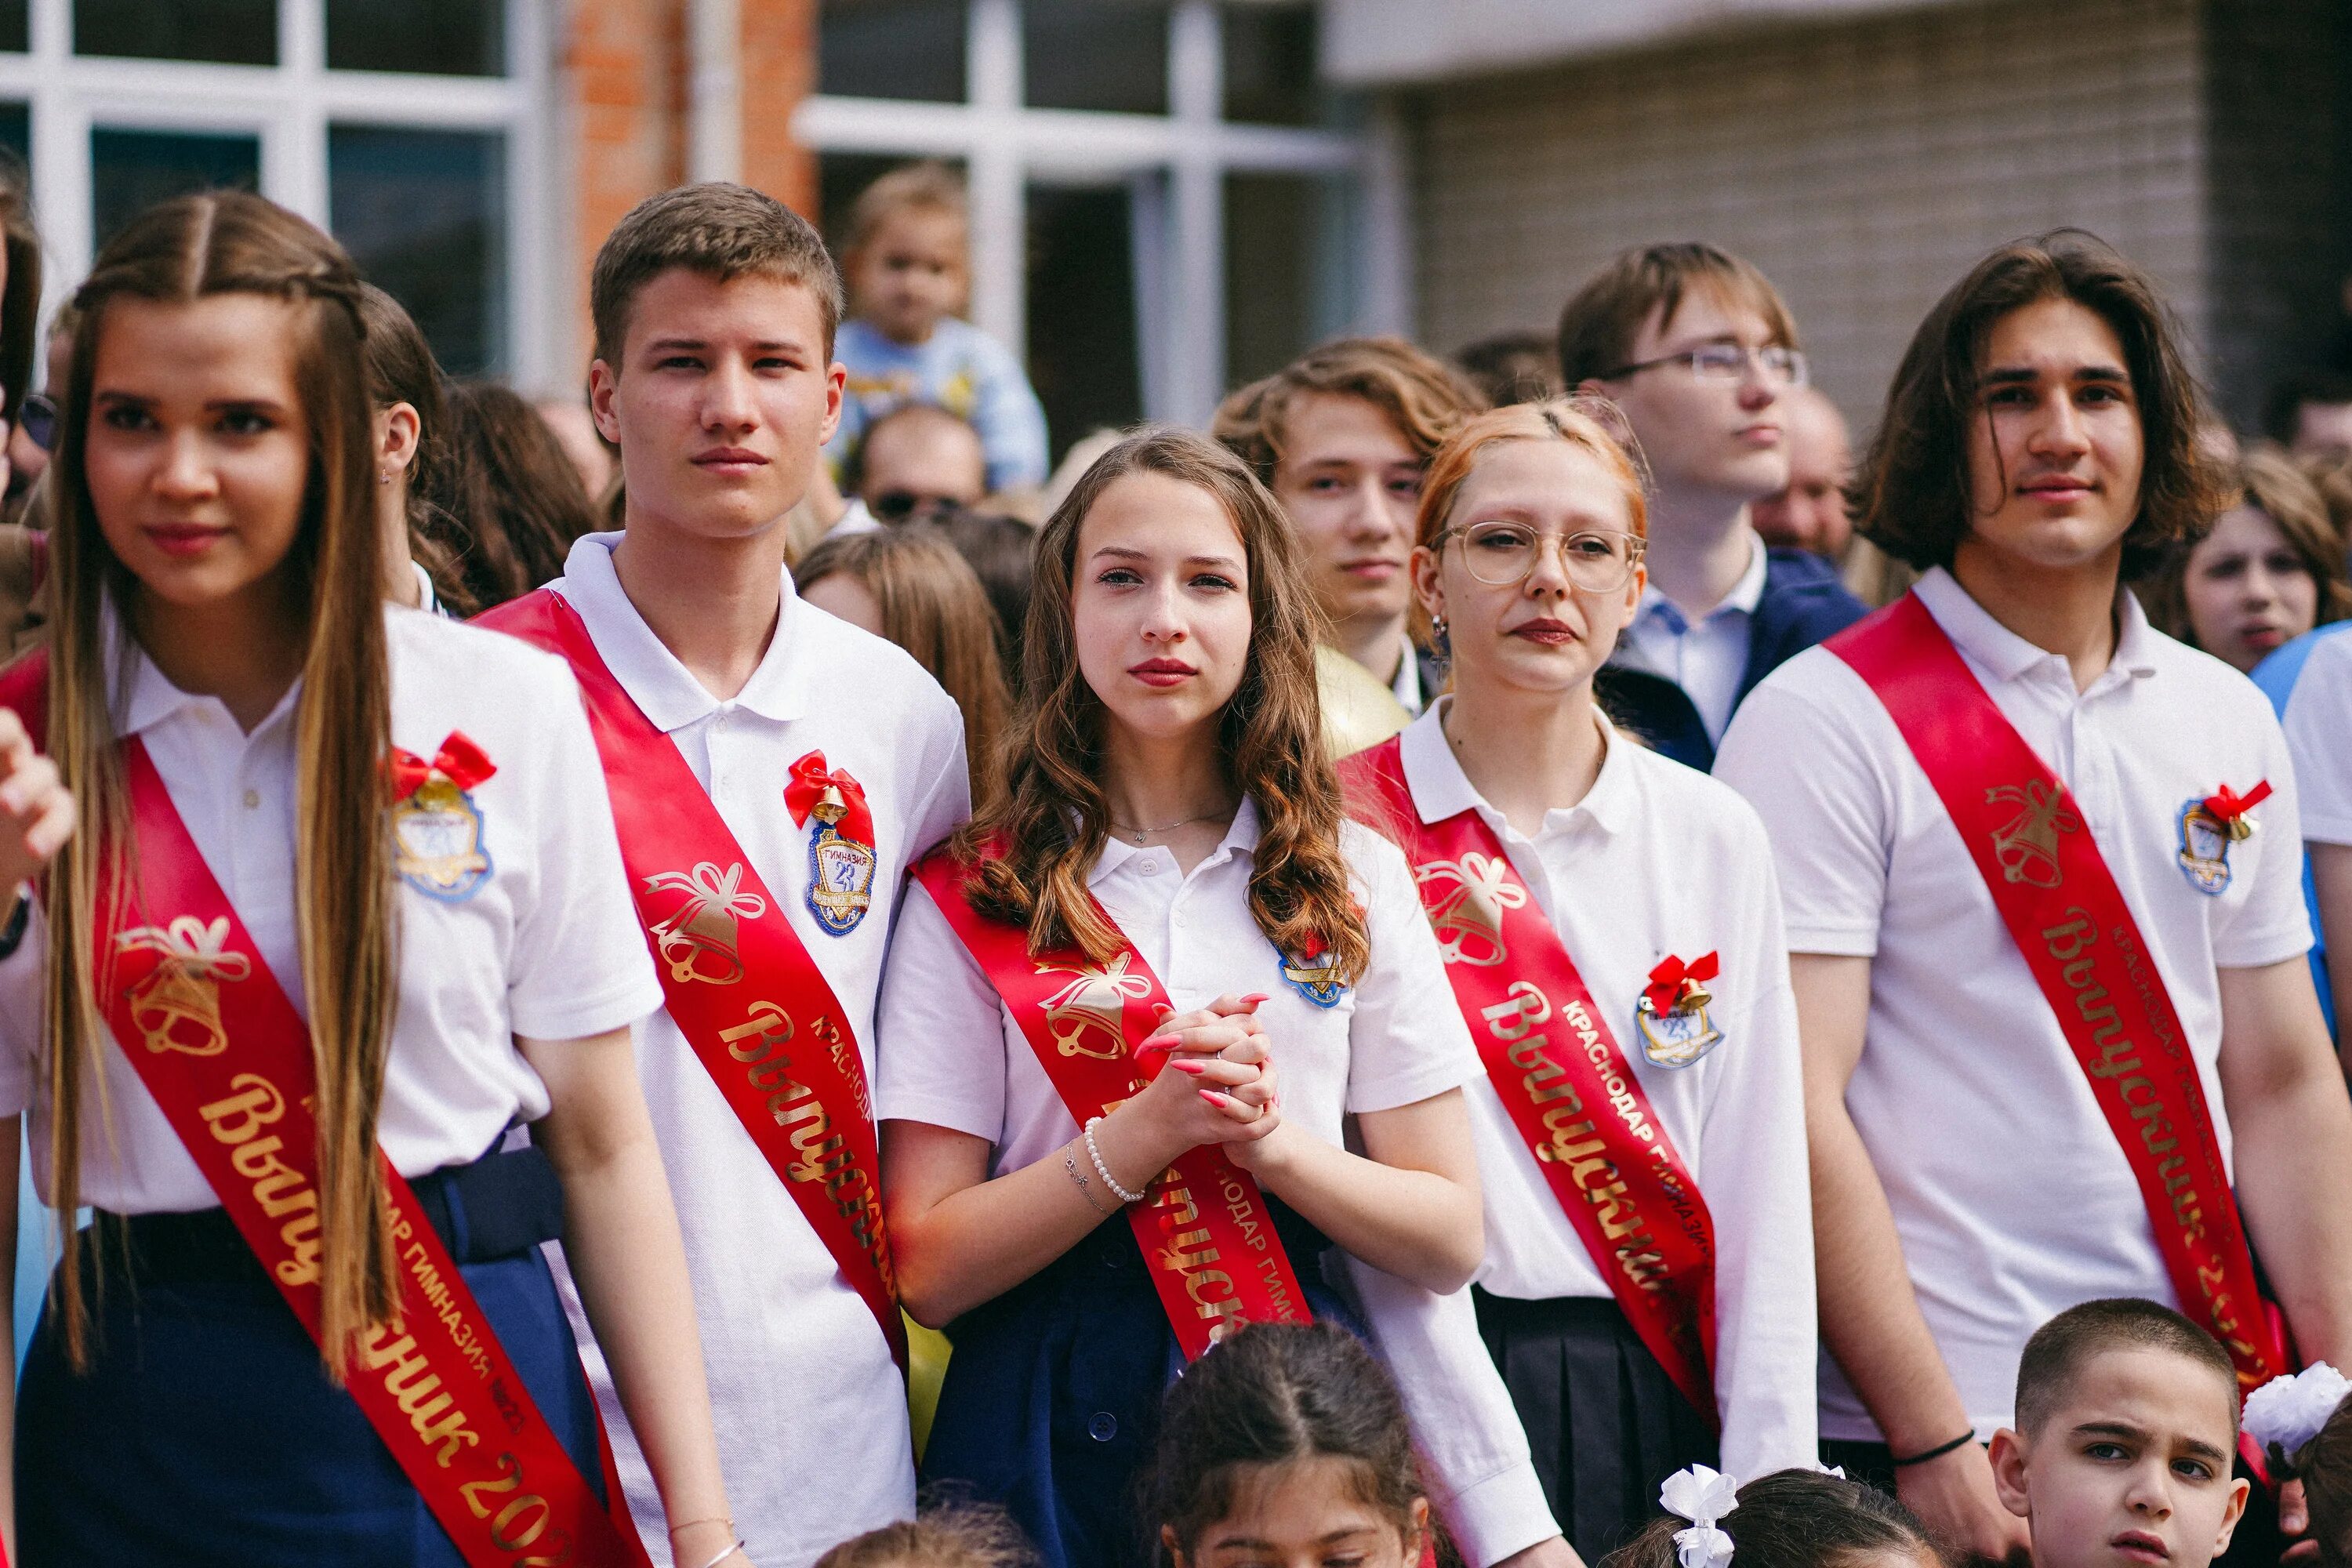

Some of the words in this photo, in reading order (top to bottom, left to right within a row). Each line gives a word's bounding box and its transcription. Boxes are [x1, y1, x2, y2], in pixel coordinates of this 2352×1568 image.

[824, 849, 868, 866] ГИМНАЗИЯ
[834, 861, 855, 892] 23
[826, 906, 834, 919] 19
[1562, 1000, 1654, 1142] КРАСНОДАР
[2042, 906, 2205, 1249] Выпускник
[404, 1242, 493, 1381] ГИМНАЗИЯ
